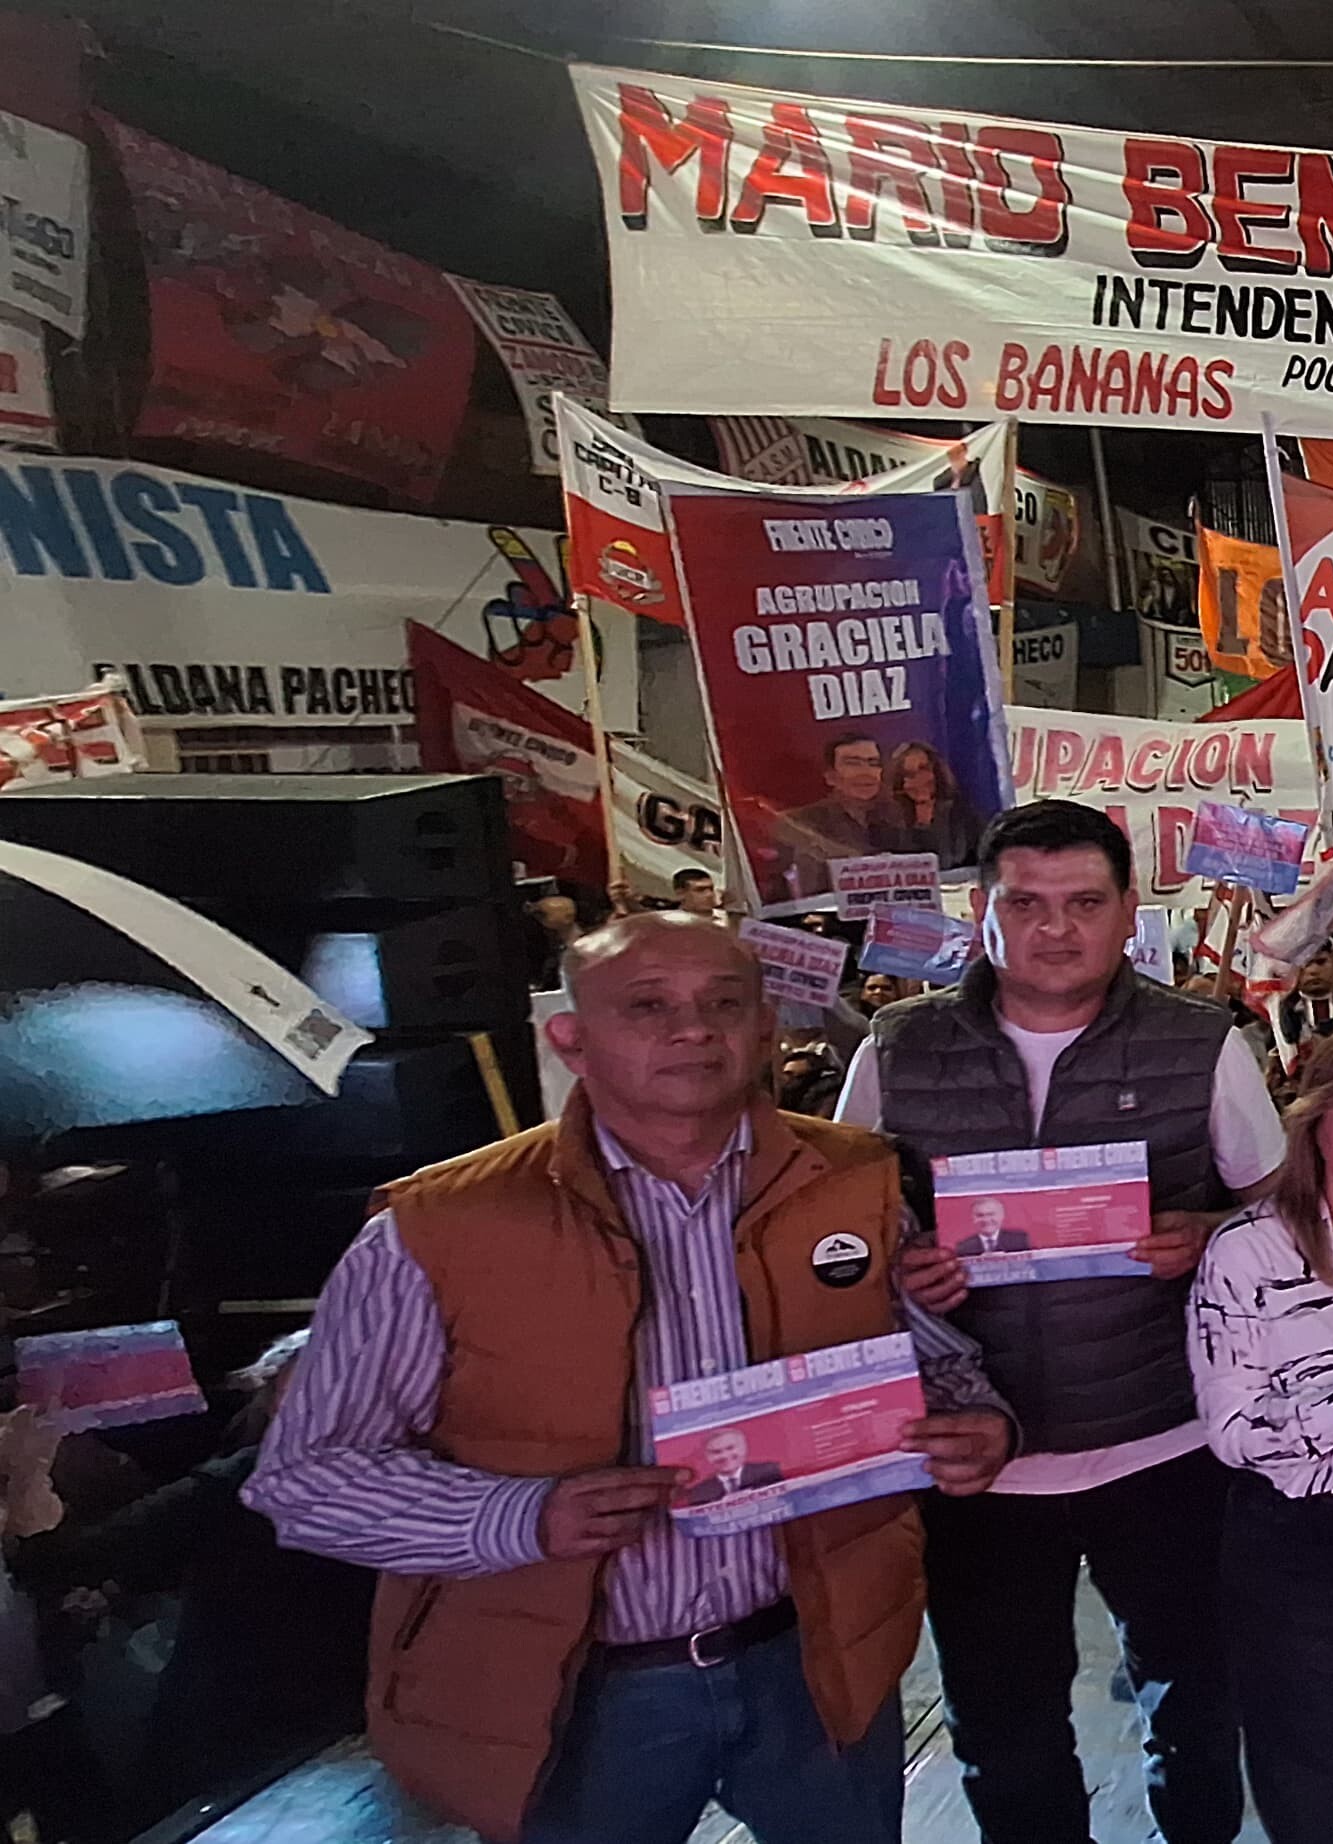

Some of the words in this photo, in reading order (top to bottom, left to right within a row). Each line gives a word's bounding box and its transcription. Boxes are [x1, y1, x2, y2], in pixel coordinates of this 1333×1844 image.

[617, 82, 1071, 257] MARIO
[873, 337, 970, 409] LOS
[995, 348, 1235, 420] BANANAS
[755, 580, 921, 616] AGRUPACION
[733, 612, 951, 674] GRACIELA
[808, 666, 912, 721] DIAZ
